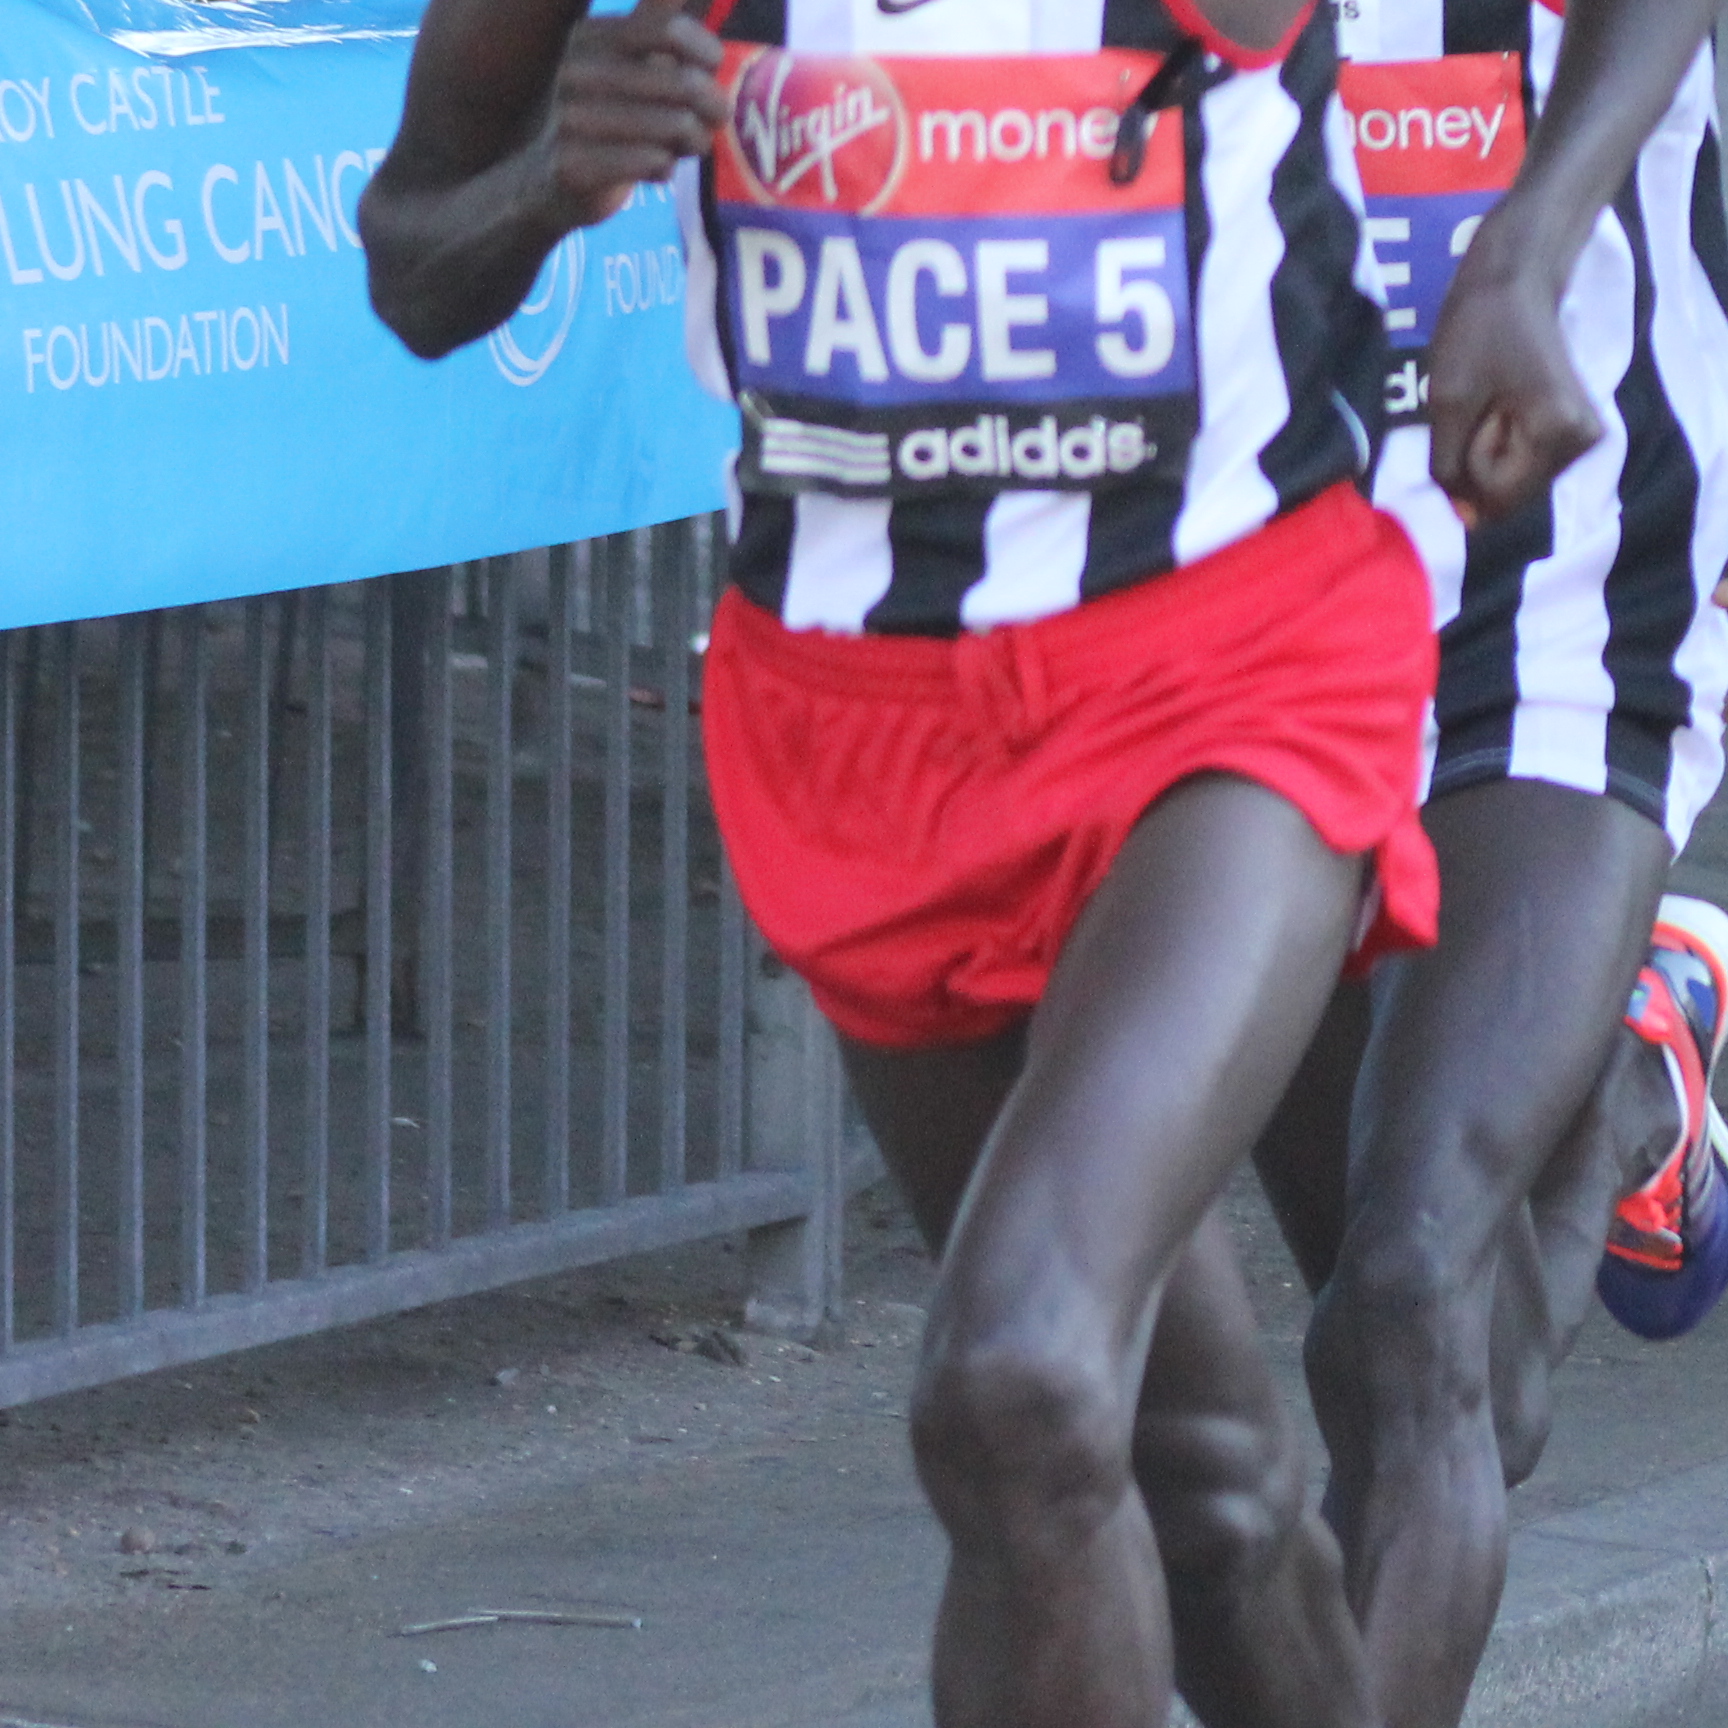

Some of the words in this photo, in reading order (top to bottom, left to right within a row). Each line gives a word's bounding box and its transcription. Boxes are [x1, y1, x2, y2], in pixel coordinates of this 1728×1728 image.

[0, 76, 55, 144] OY
[69, 65, 226, 136] CASTLE
[740, 52, 890, 204] Virgin
[919, 107, 1158, 162] mone
[0, 170, 188, 286] LUNG
[202, 148, 386, 264] CANC
[23, 302, 289, 394] FOUNDATION
[736, 227, 1057, 383] PACE
[1095, 235, 1176, 379] 5
[899, 414, 1147, 481] adidas
